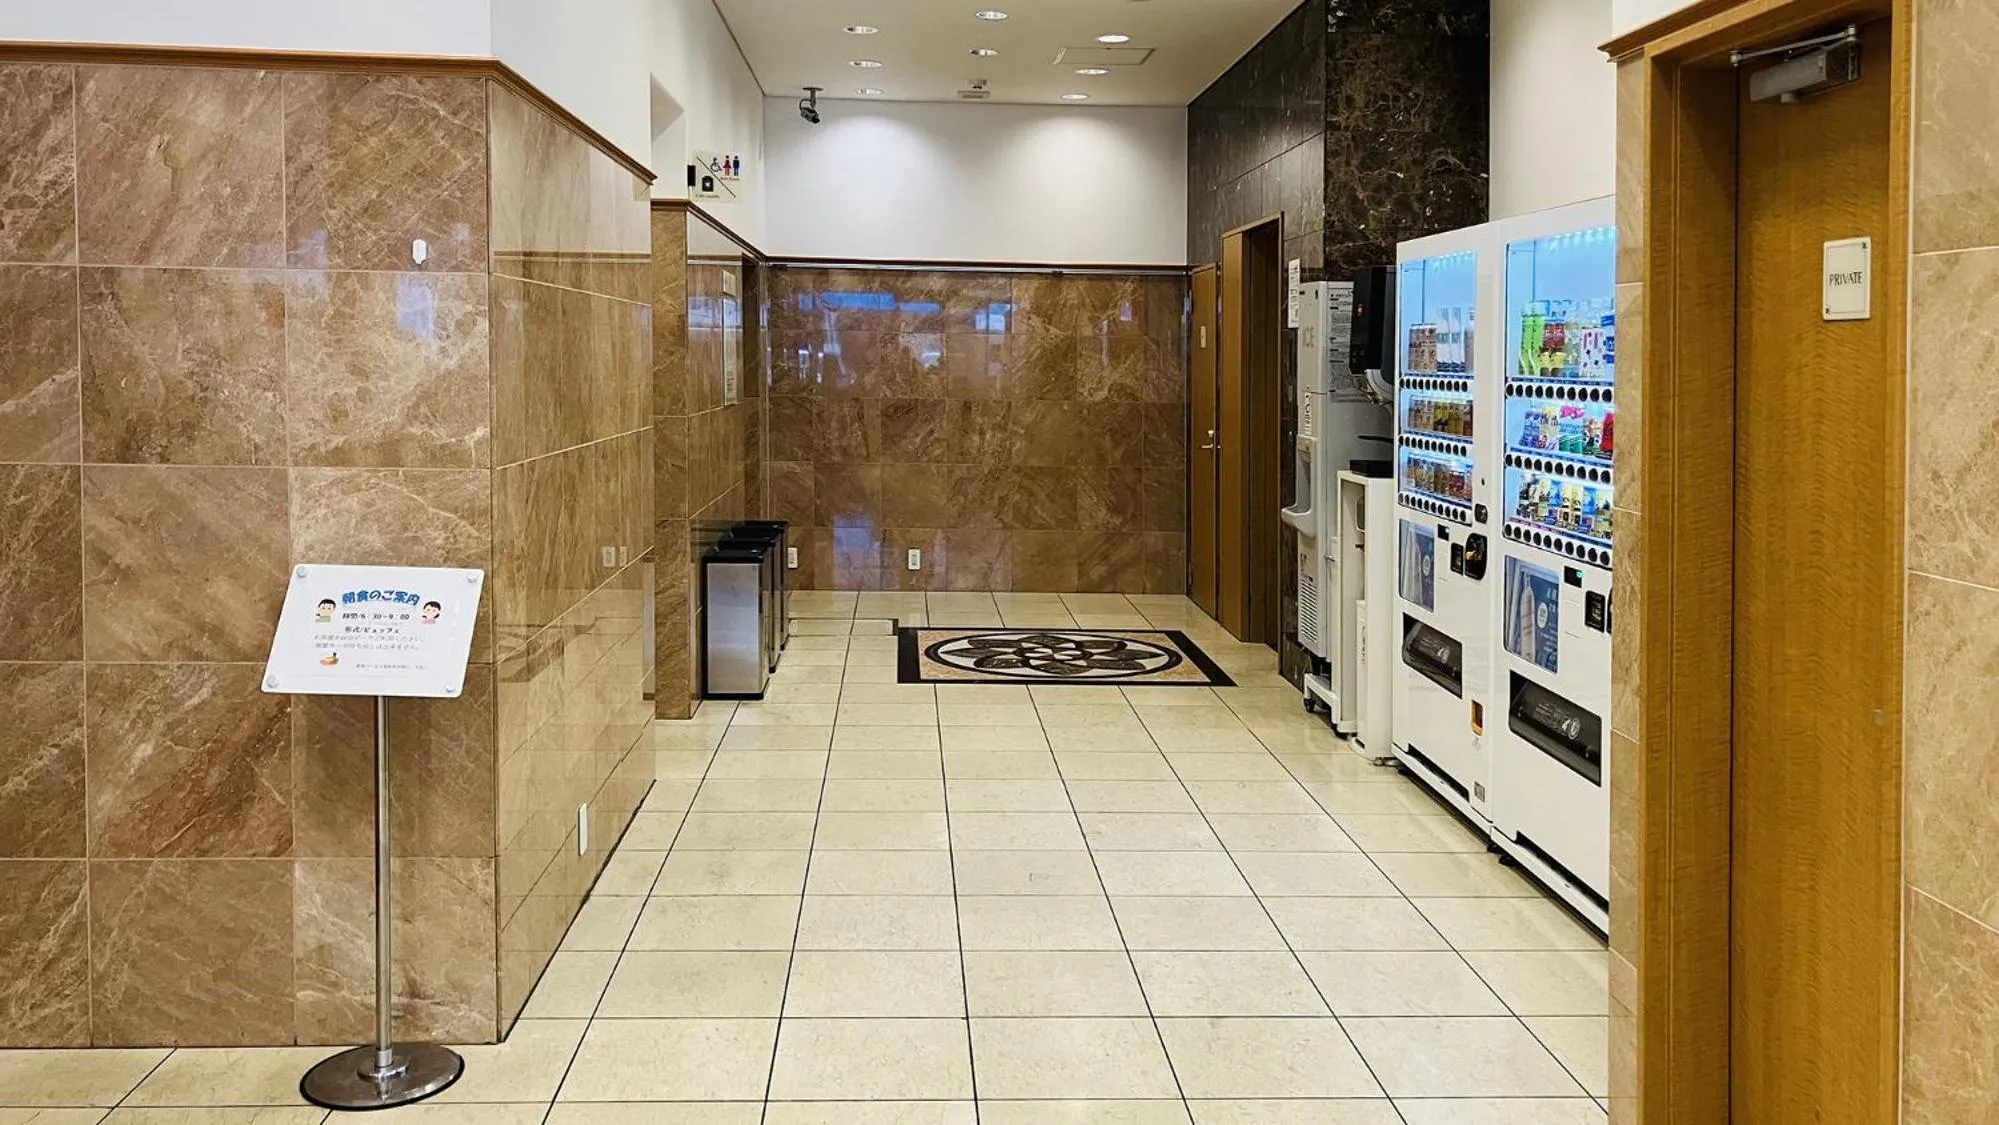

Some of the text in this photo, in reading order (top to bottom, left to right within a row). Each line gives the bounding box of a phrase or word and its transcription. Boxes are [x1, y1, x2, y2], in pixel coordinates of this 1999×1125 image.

[1829, 271, 1862, 285] PRIVATE
[342, 590, 420, 606] 朝食のご案内
